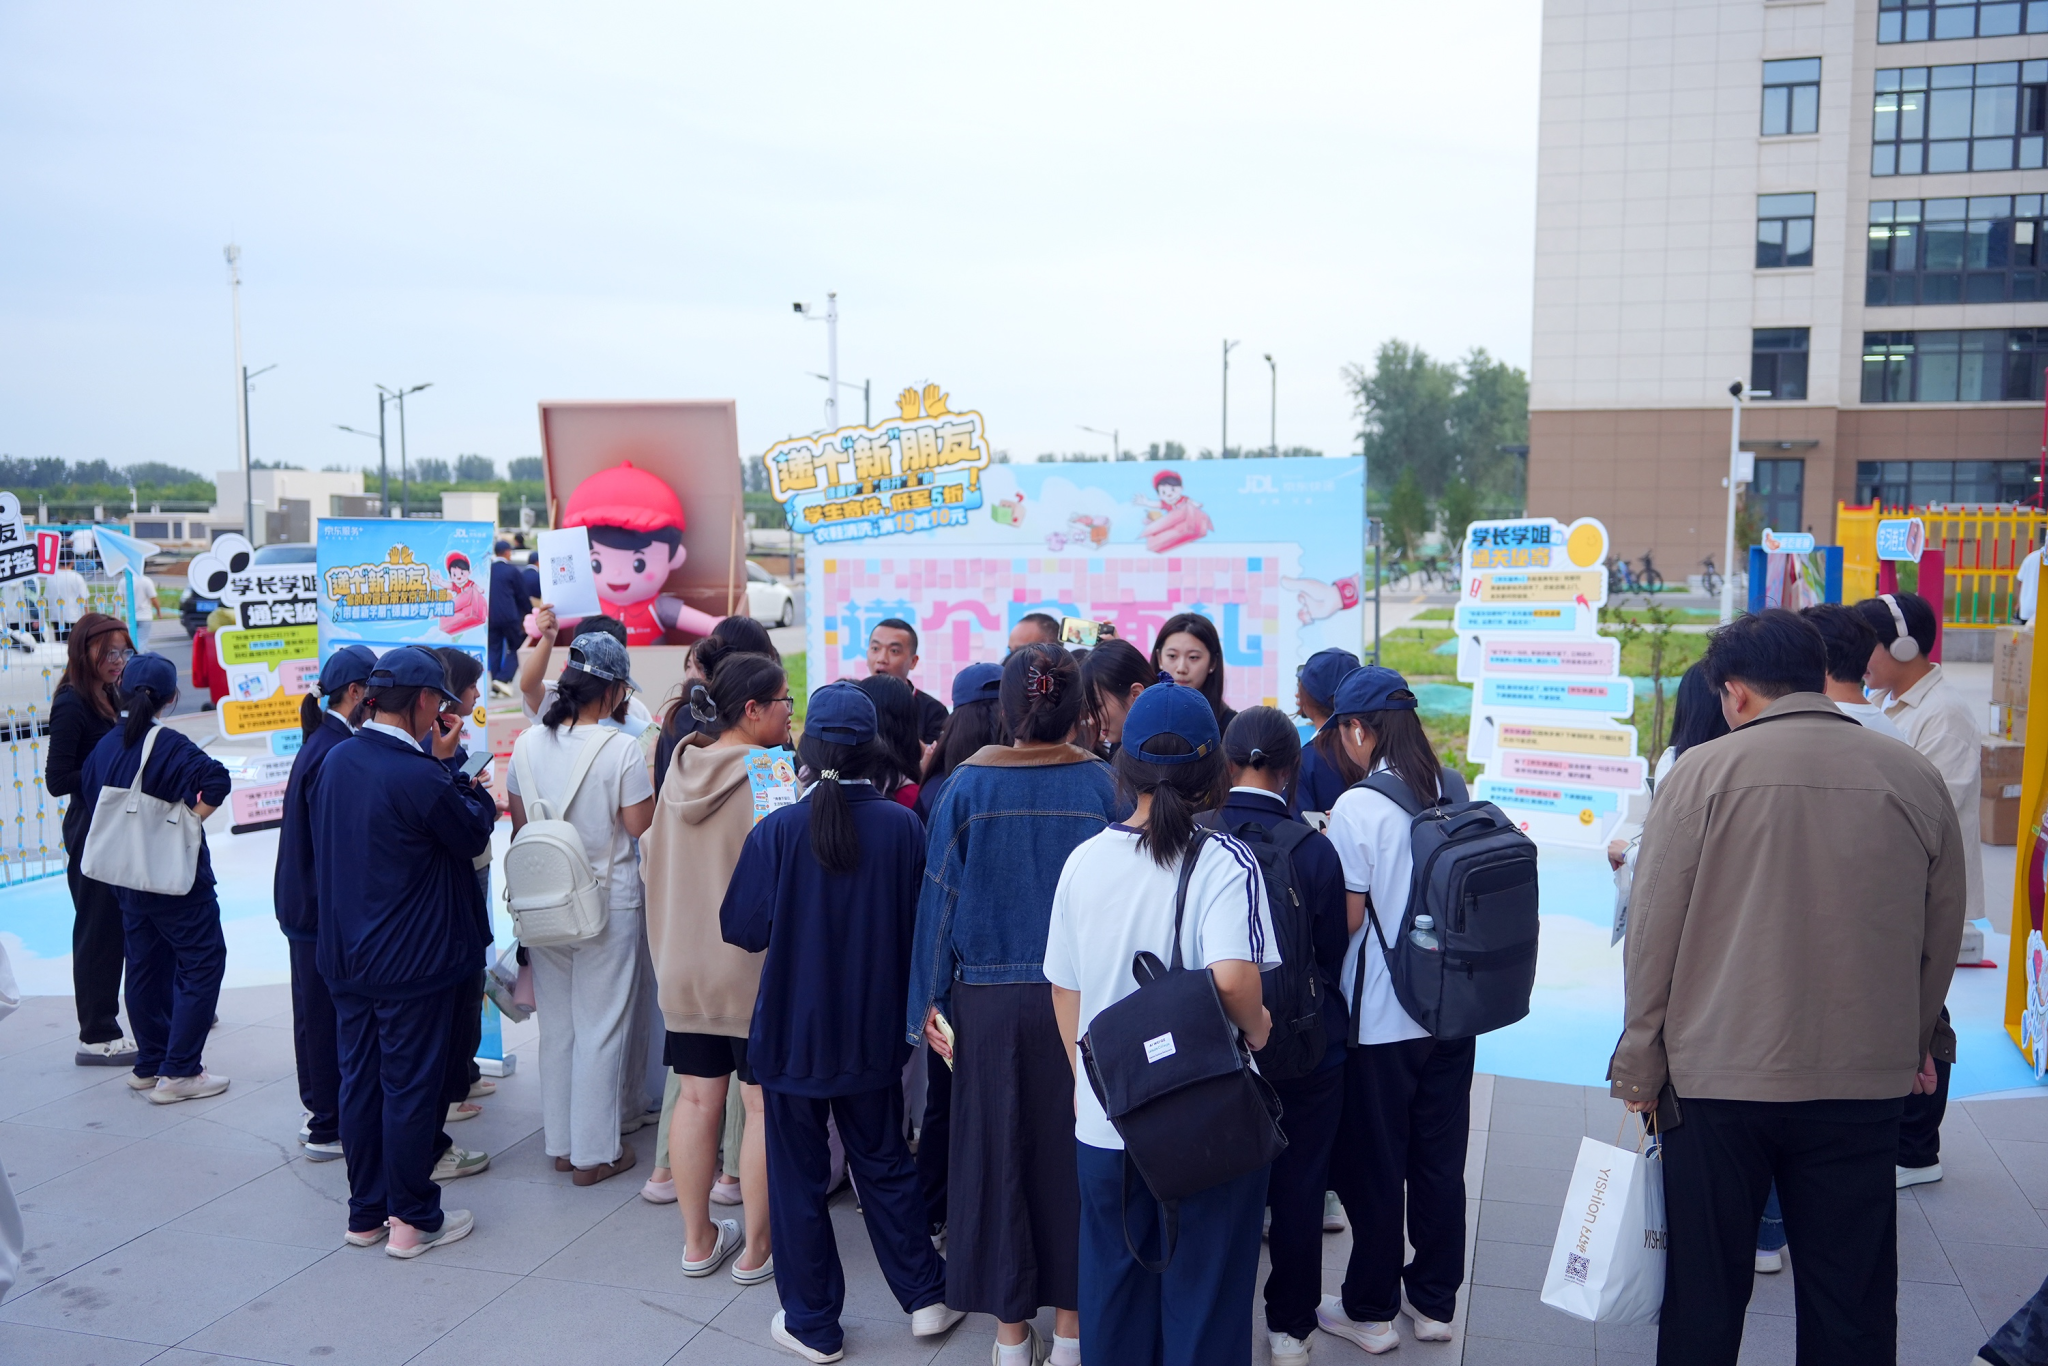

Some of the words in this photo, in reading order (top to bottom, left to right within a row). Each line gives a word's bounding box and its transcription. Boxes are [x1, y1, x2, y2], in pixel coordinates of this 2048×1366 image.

[1238, 474, 1279, 494] JDL
[1473, 526, 1551, 547] 学长学姐
